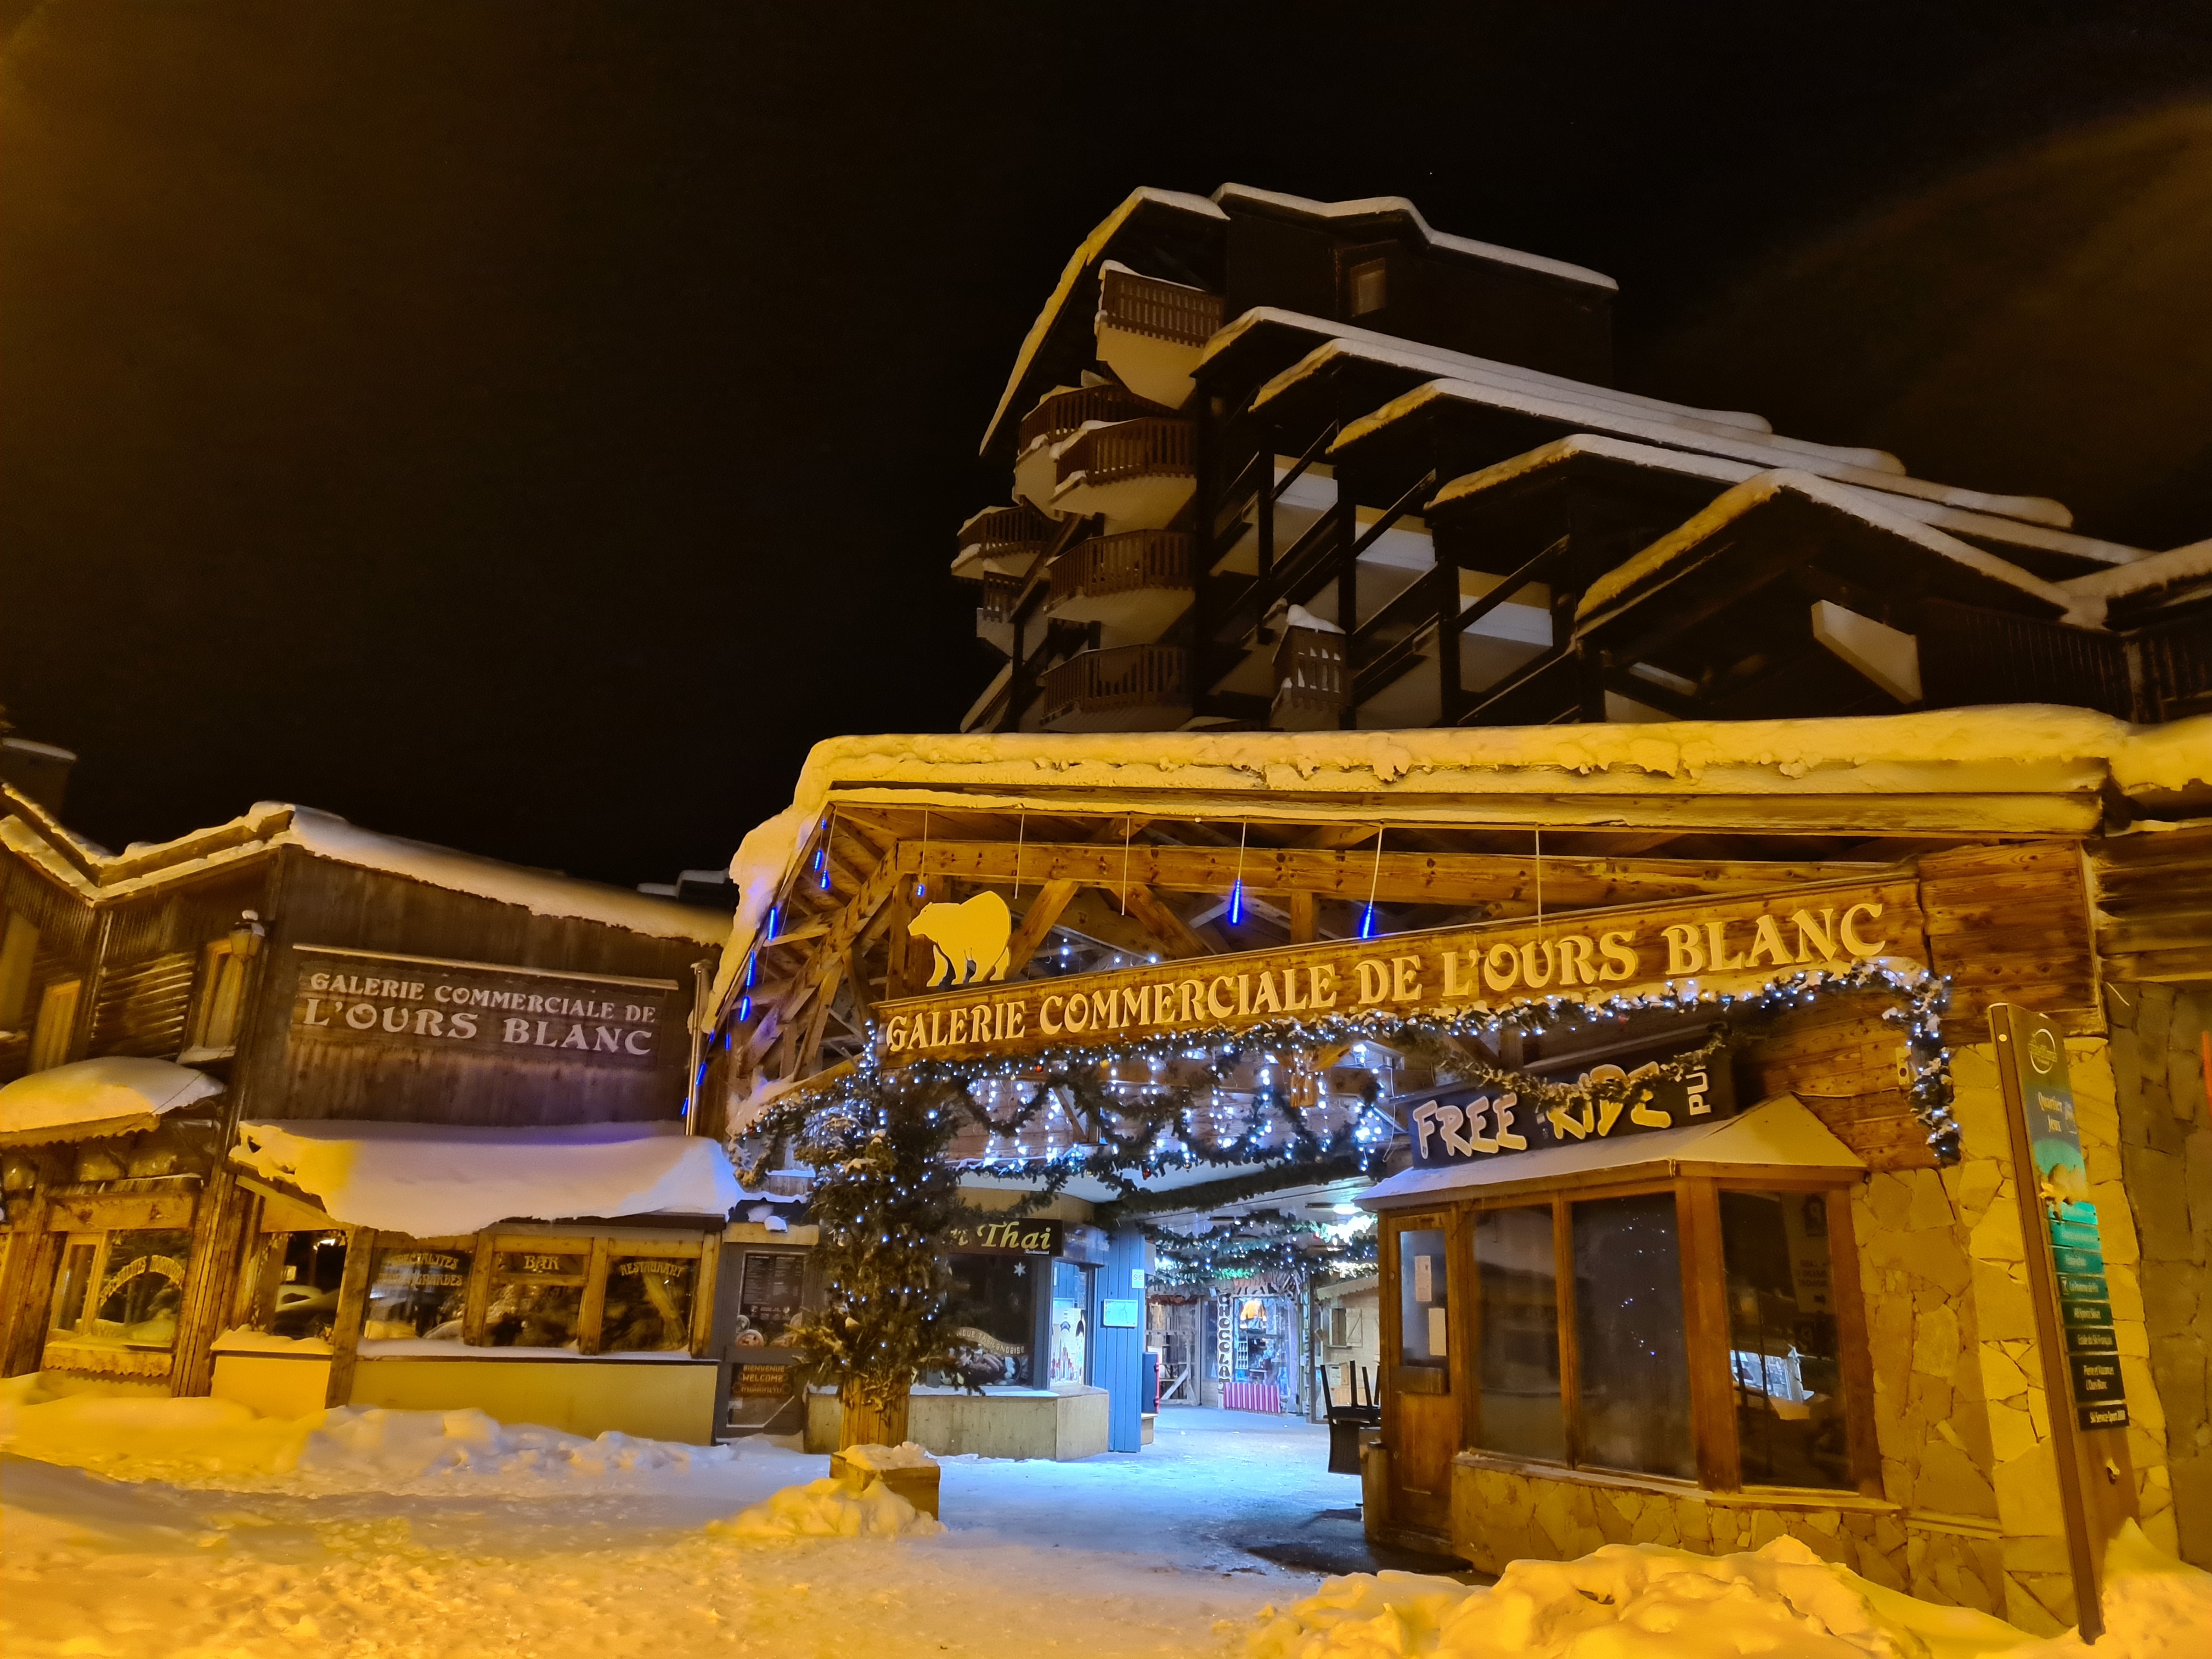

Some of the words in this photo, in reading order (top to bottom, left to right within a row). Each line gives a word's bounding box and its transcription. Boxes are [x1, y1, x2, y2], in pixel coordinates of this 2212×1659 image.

[311, 972, 425, 1001] GALERIE
[435, 986, 614, 1019] COMMERCIALE
[625, 1005, 656, 1023] DE
[886, 1001, 1026, 1052] GALERIE
[1040, 963, 1336, 1035] COMMERCIALE
[1355, 955, 1422, 1005] DE
[1442, 930, 1639, 997] L'OURS
[1662, 903, 1886, 975] BLANC
[303, 998, 478, 1040] L'OURS
[503, 1018, 652, 1056] BLANC
[1413, 1092, 1528, 1159] FREE
[977, 1221, 1051, 1250] Thai
[523, 1255, 558, 1270] BAR
[619, 1261, 685, 1277] RESTAURANT
[742, 1373, 783, 1382] WELCOME
